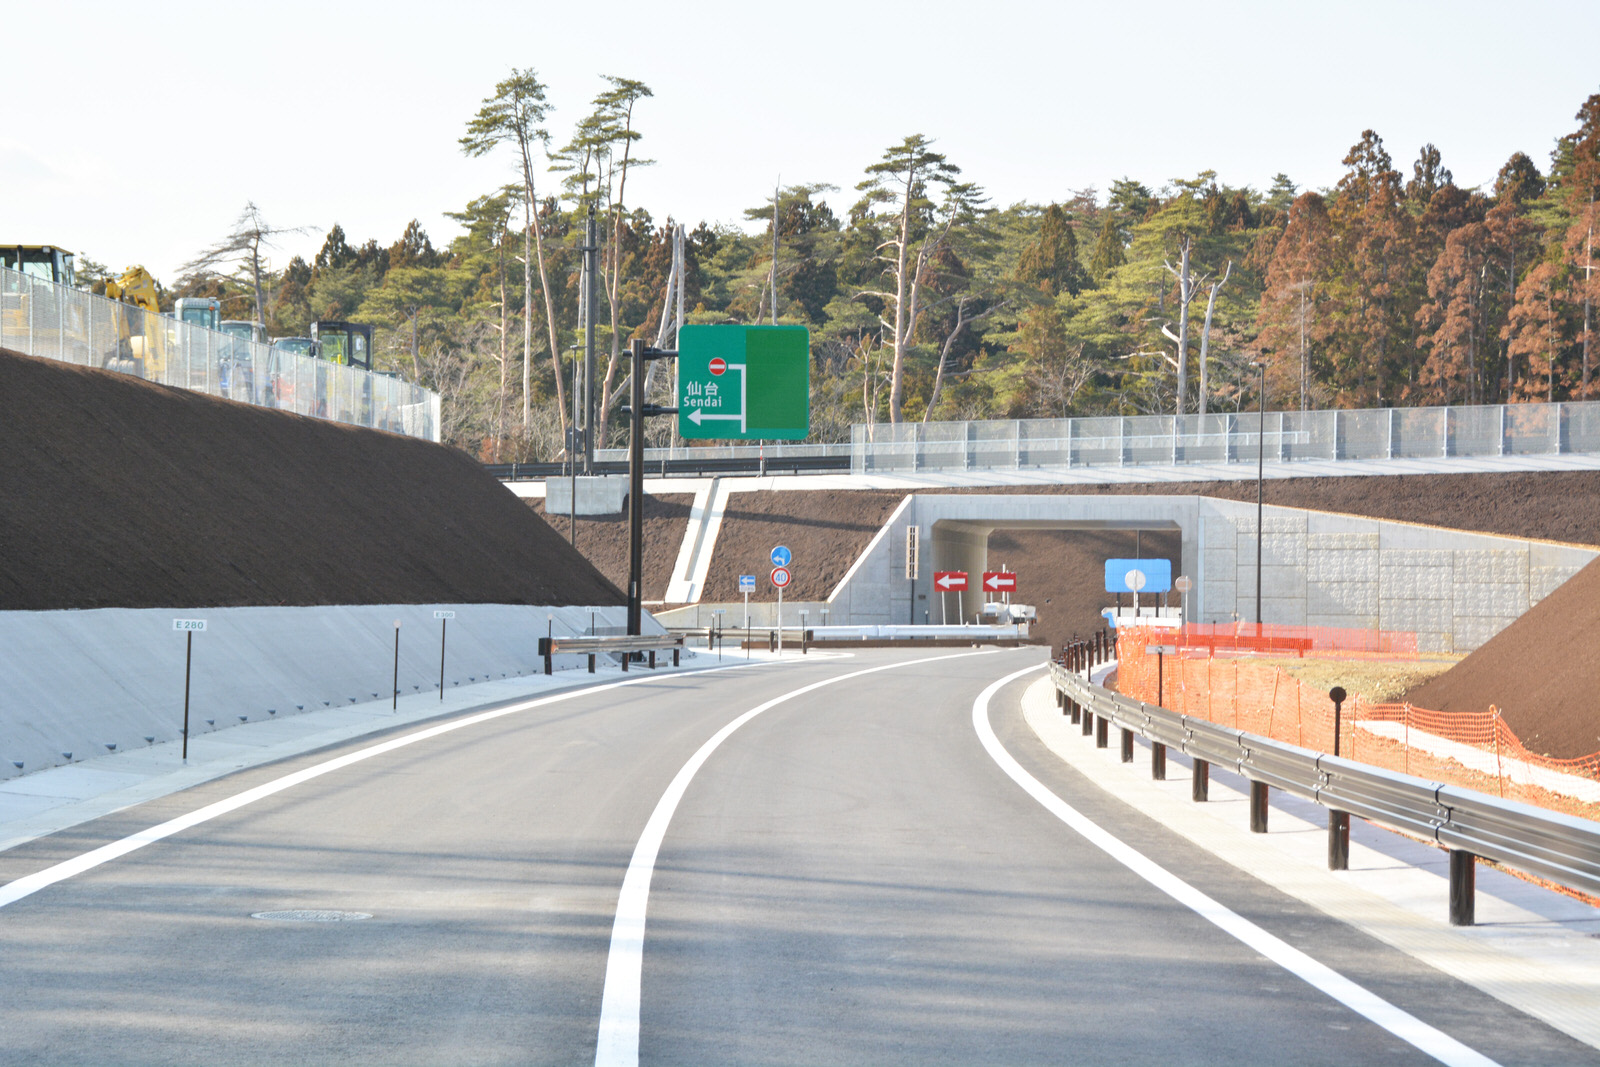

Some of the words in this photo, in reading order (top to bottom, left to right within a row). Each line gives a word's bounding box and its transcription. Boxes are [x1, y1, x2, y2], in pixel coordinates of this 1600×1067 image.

[686, 381, 719, 396] 仙台
[683, 396, 722, 407] Sendai
[775, 573, 787, 582] 40
[176, 621, 182, 629] E
[184, 621, 204, 629] 280
